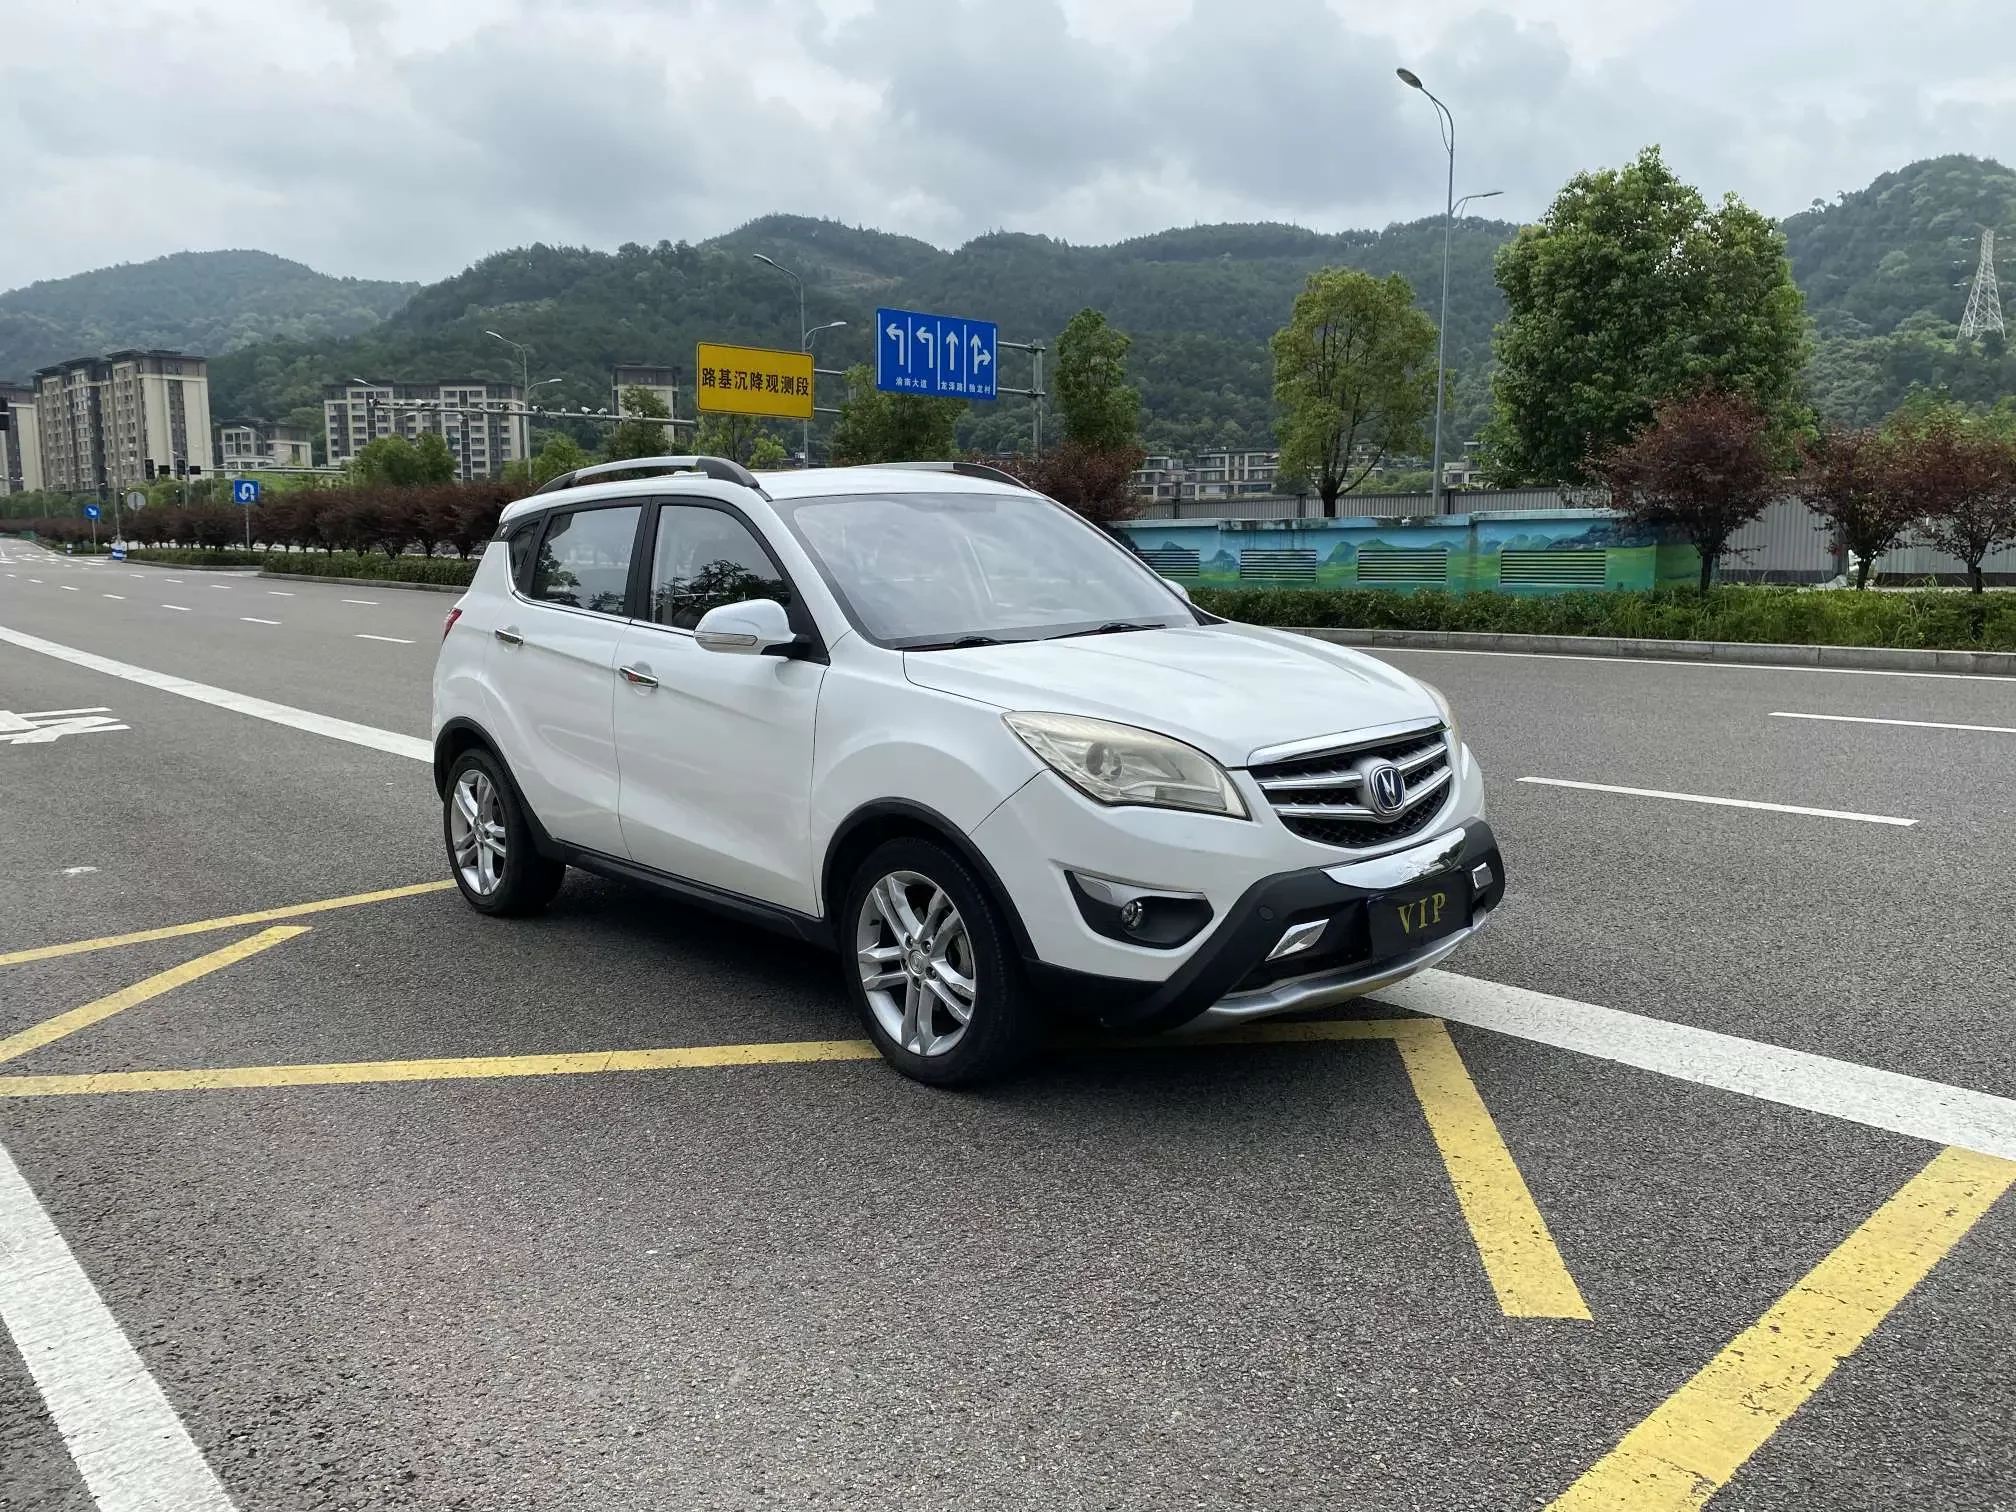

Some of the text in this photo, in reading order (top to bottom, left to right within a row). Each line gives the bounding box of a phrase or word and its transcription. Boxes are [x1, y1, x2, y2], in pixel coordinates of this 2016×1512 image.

[702, 367, 809, 396] 路基沉降观测段
[895, 376, 928, 389] 渝南大道
[1397, 893, 1446, 934] VIP
